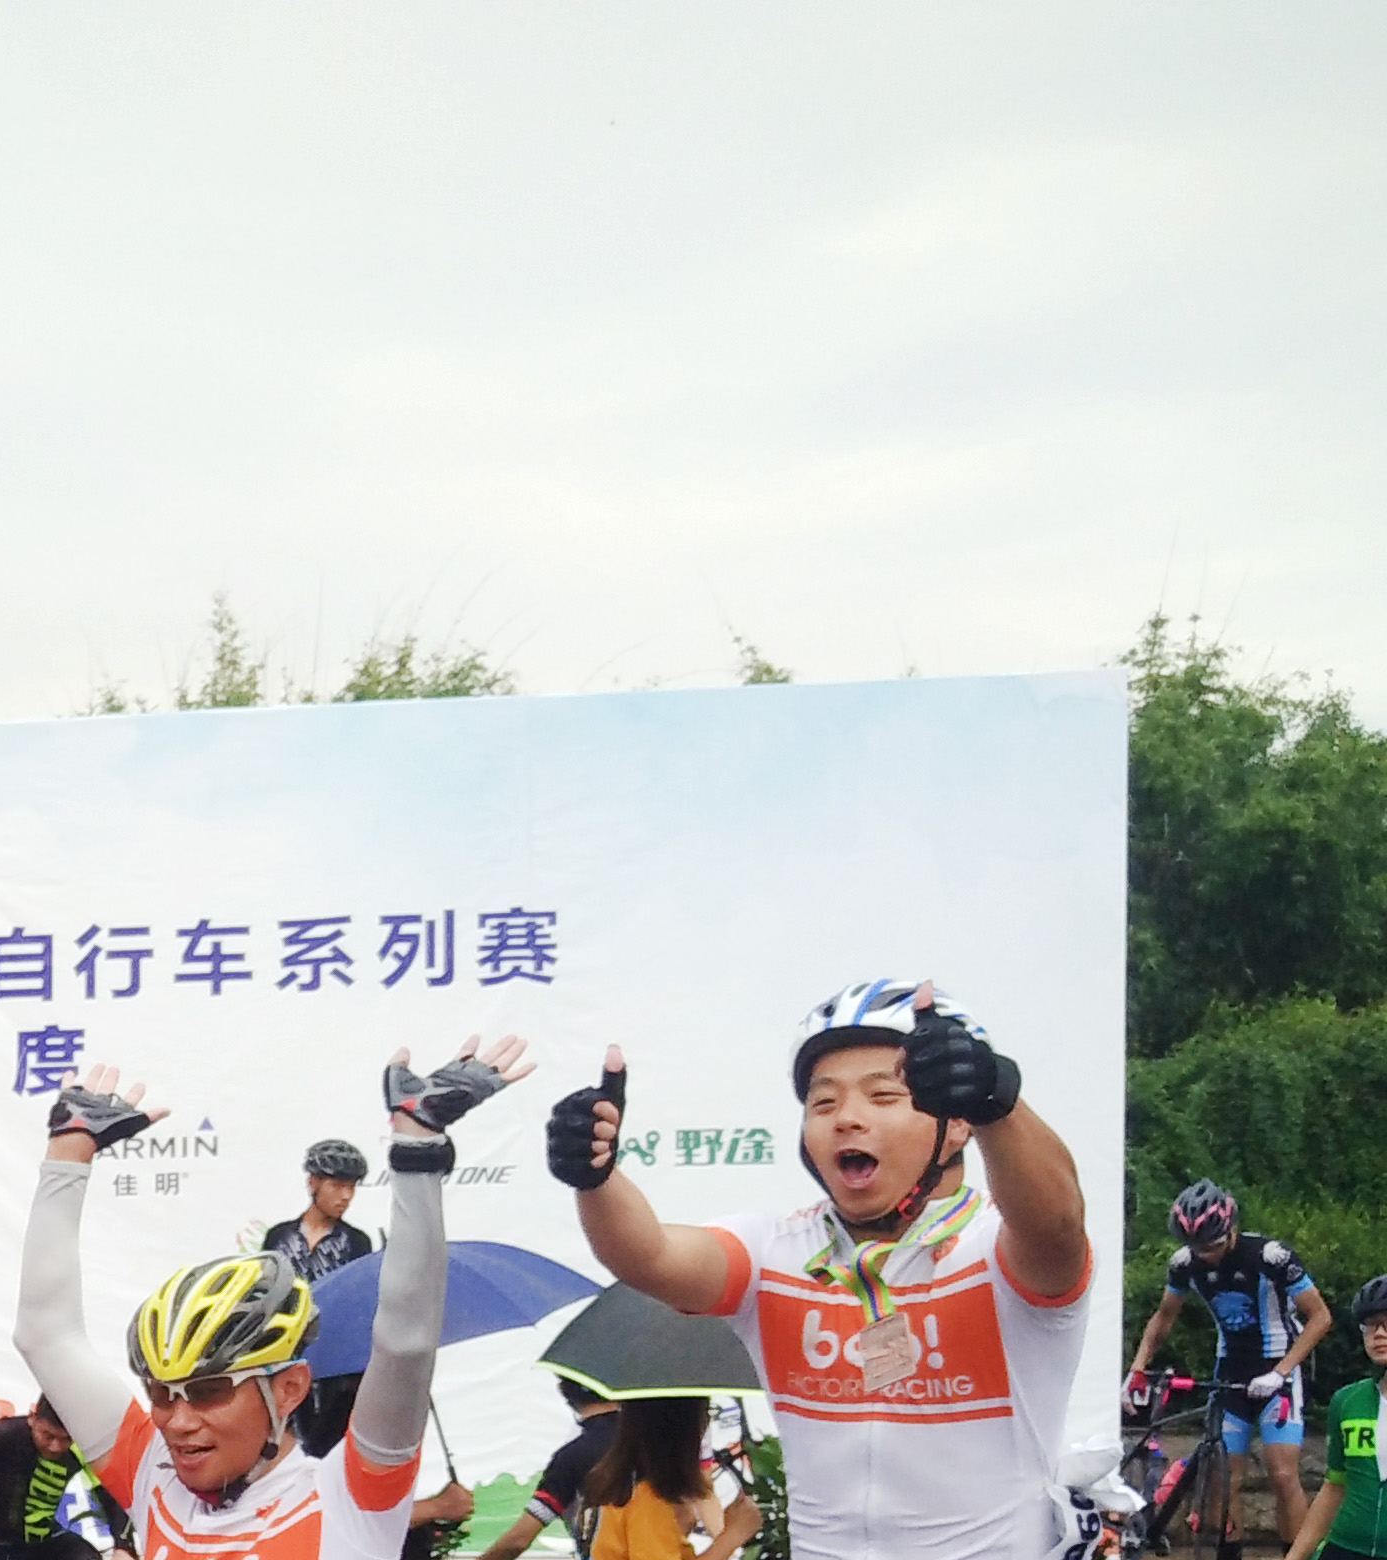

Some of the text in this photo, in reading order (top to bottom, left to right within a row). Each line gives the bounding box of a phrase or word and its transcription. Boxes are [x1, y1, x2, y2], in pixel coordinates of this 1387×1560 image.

[97, 1135, 219, 1160] ARMIN
[674, 1128, 775, 1166] 野途
[112, 1172, 180, 1197] 佳明
